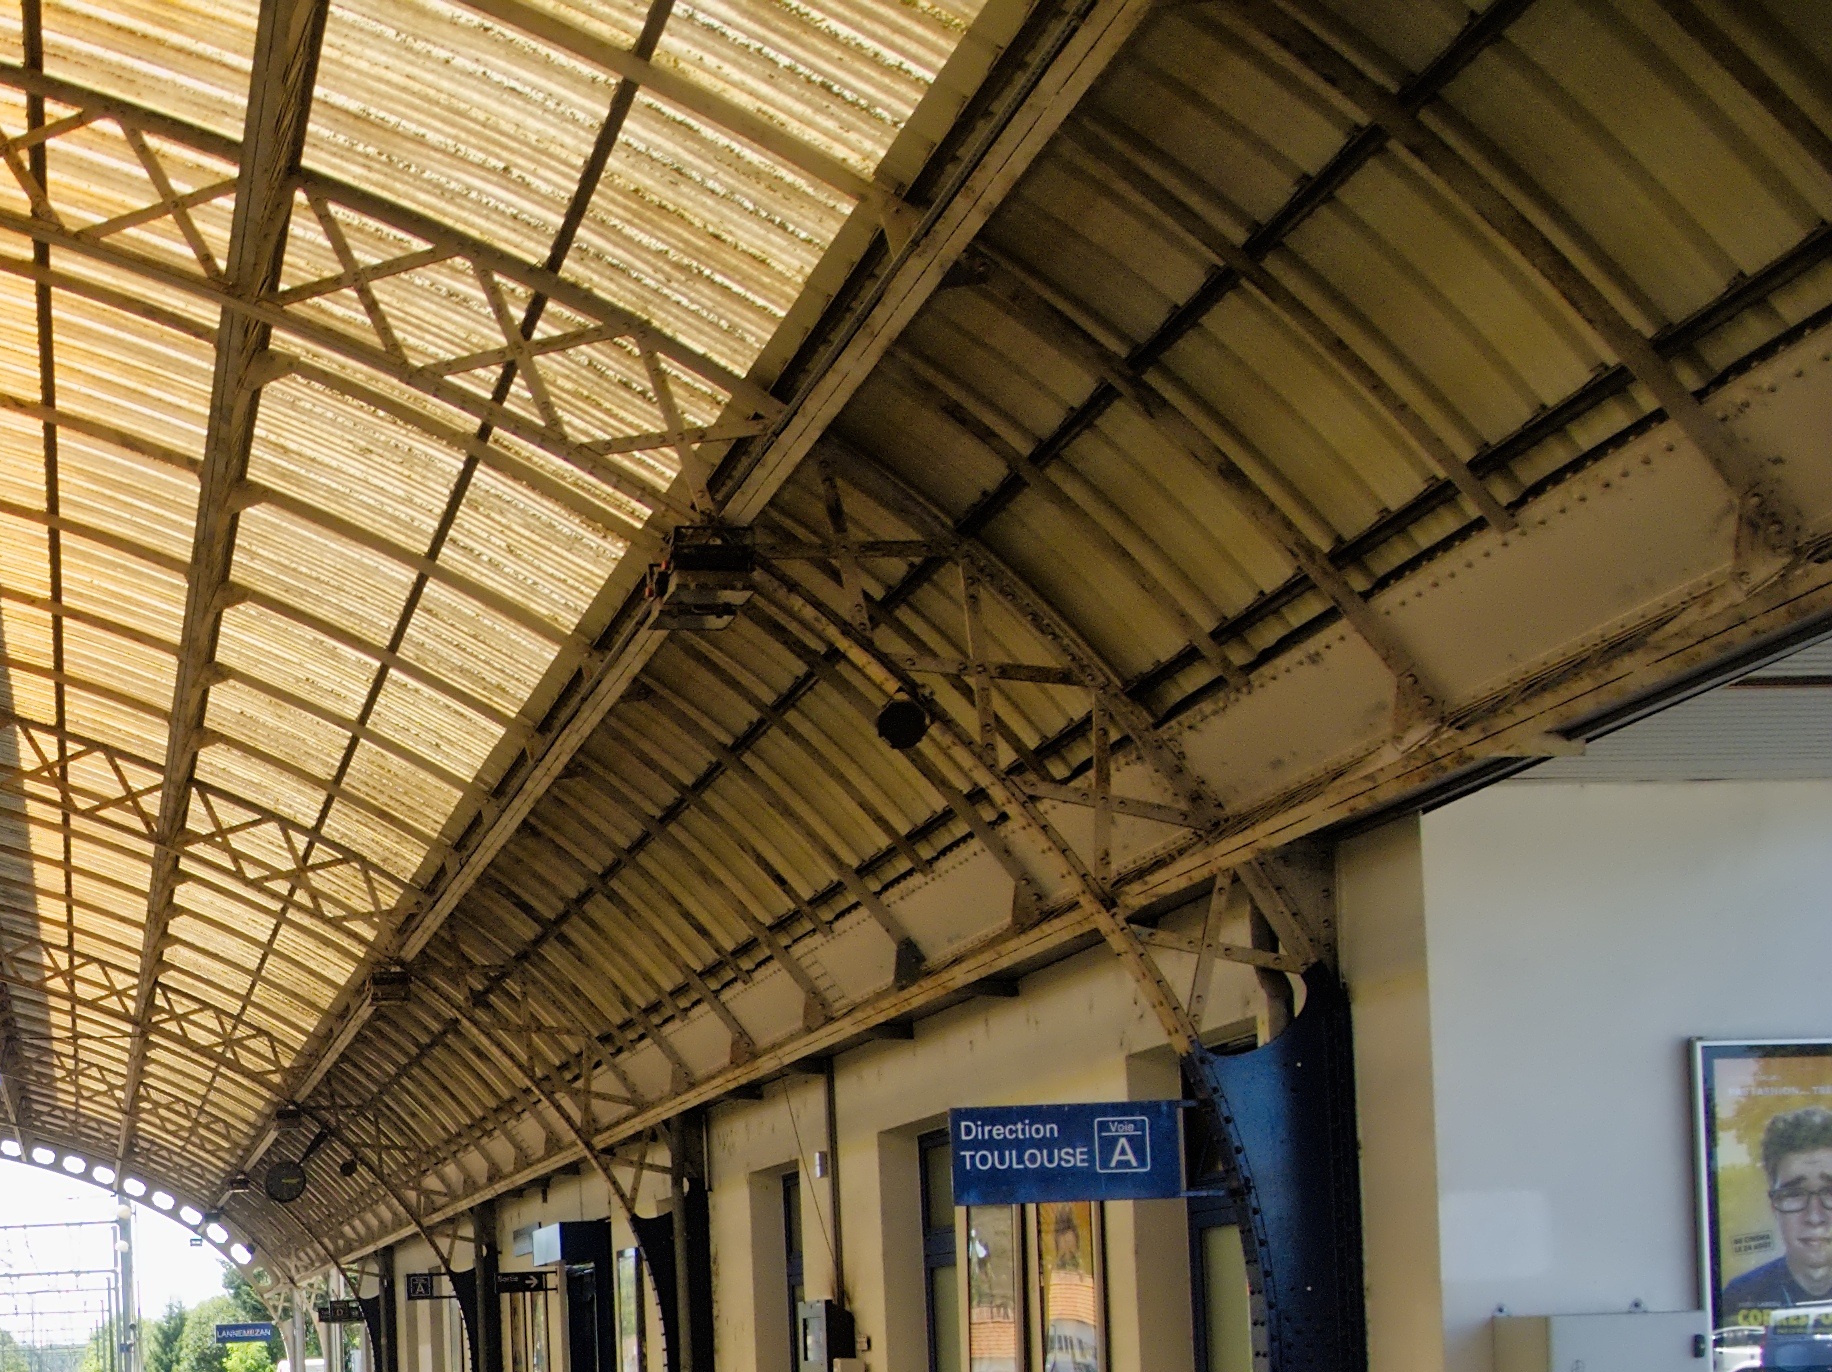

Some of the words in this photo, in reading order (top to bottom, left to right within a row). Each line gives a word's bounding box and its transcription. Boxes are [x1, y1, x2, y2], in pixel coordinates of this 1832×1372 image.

[960, 1119, 1058, 1140] Direction
[1109, 1121, 1134, 1133] Voie
[960, 1147, 1089, 1170] TOULOUSE
[1109, 1136, 1138, 1168] A
[415, 1282, 425, 1294] A
